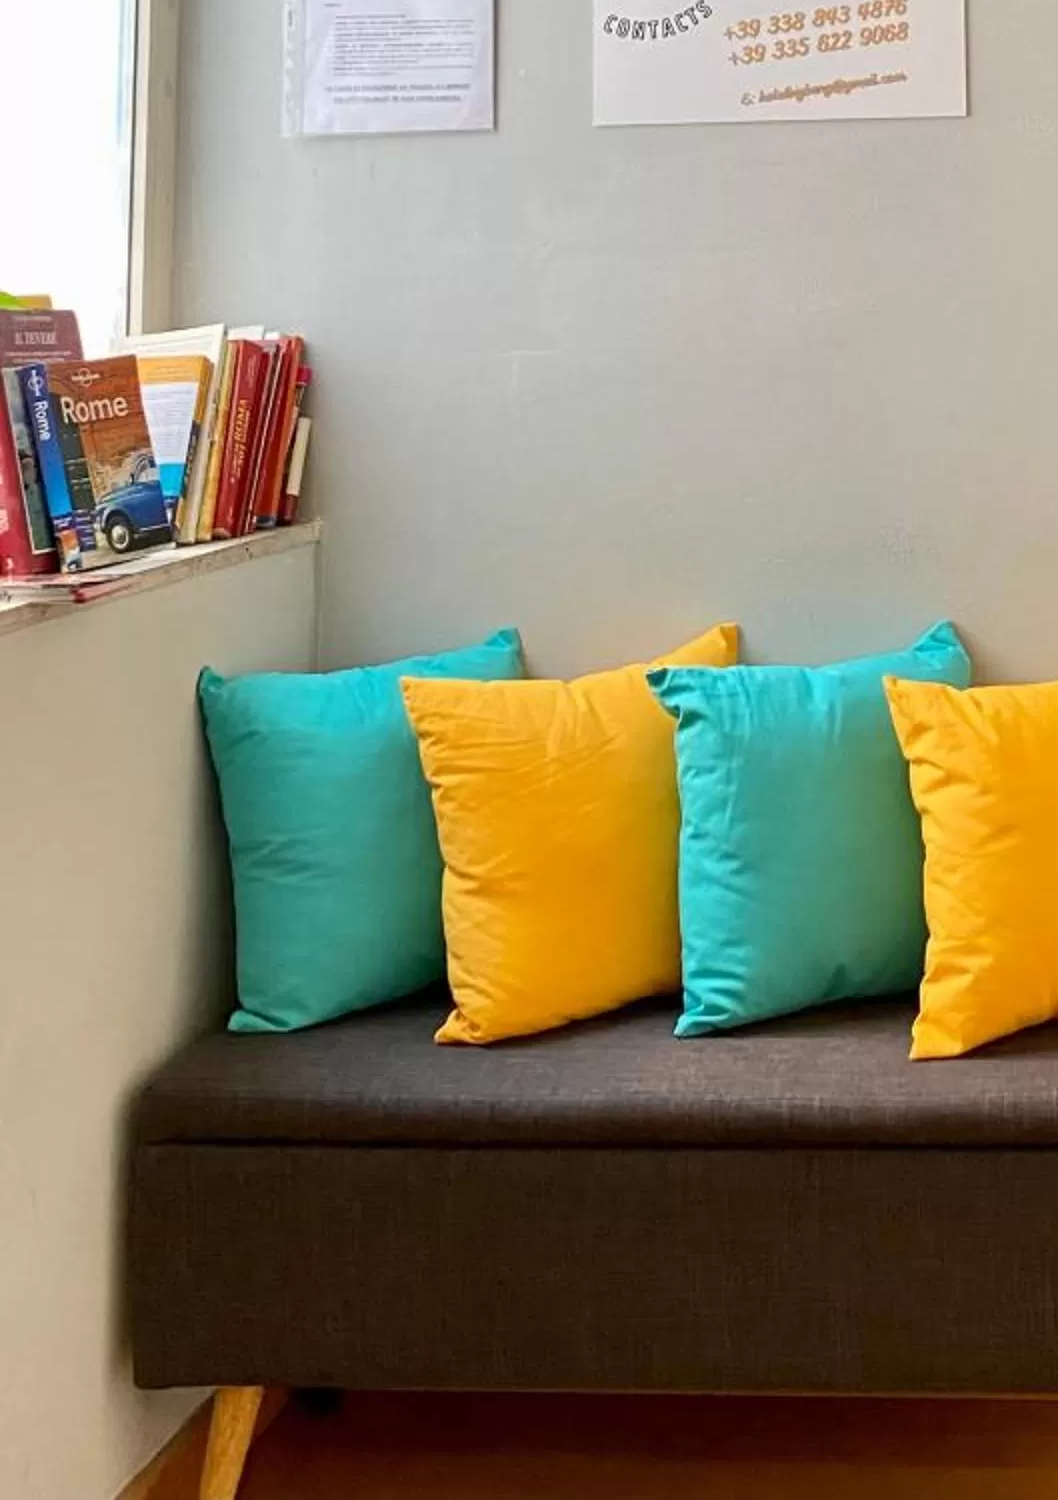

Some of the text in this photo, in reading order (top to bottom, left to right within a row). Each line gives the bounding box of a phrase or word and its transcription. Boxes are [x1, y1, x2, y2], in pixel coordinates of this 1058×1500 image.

[603, 0, 713, 41] CONTACTS
[723, 18, 761, 41] +39
[767, 11, 806, 35] 338
[728, 43, 766, 67] +39
[772, 36, 811, 60] 335
[32, 400, 51, 442] Rome
[60, 395, 130, 424] Rome
